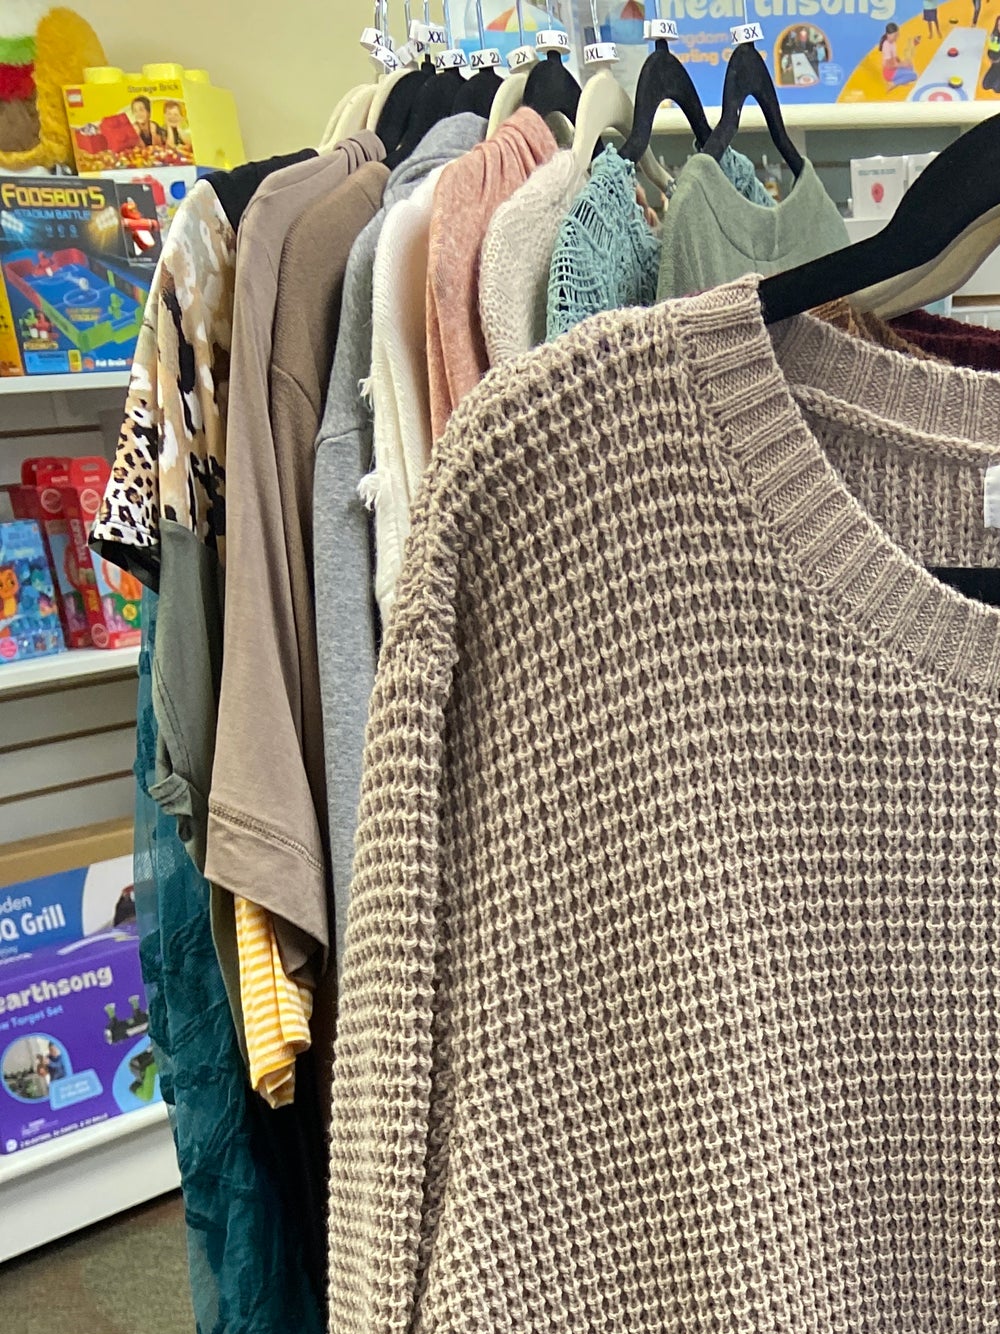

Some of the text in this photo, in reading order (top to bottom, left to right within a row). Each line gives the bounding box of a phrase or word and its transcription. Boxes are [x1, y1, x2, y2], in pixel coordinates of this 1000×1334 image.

[660, 22, 678, 35] 3XL
[744, 27, 758, 39] 3X
[515, 51, 528, 64] 2X
[21, 903, 66, 936] Grill
